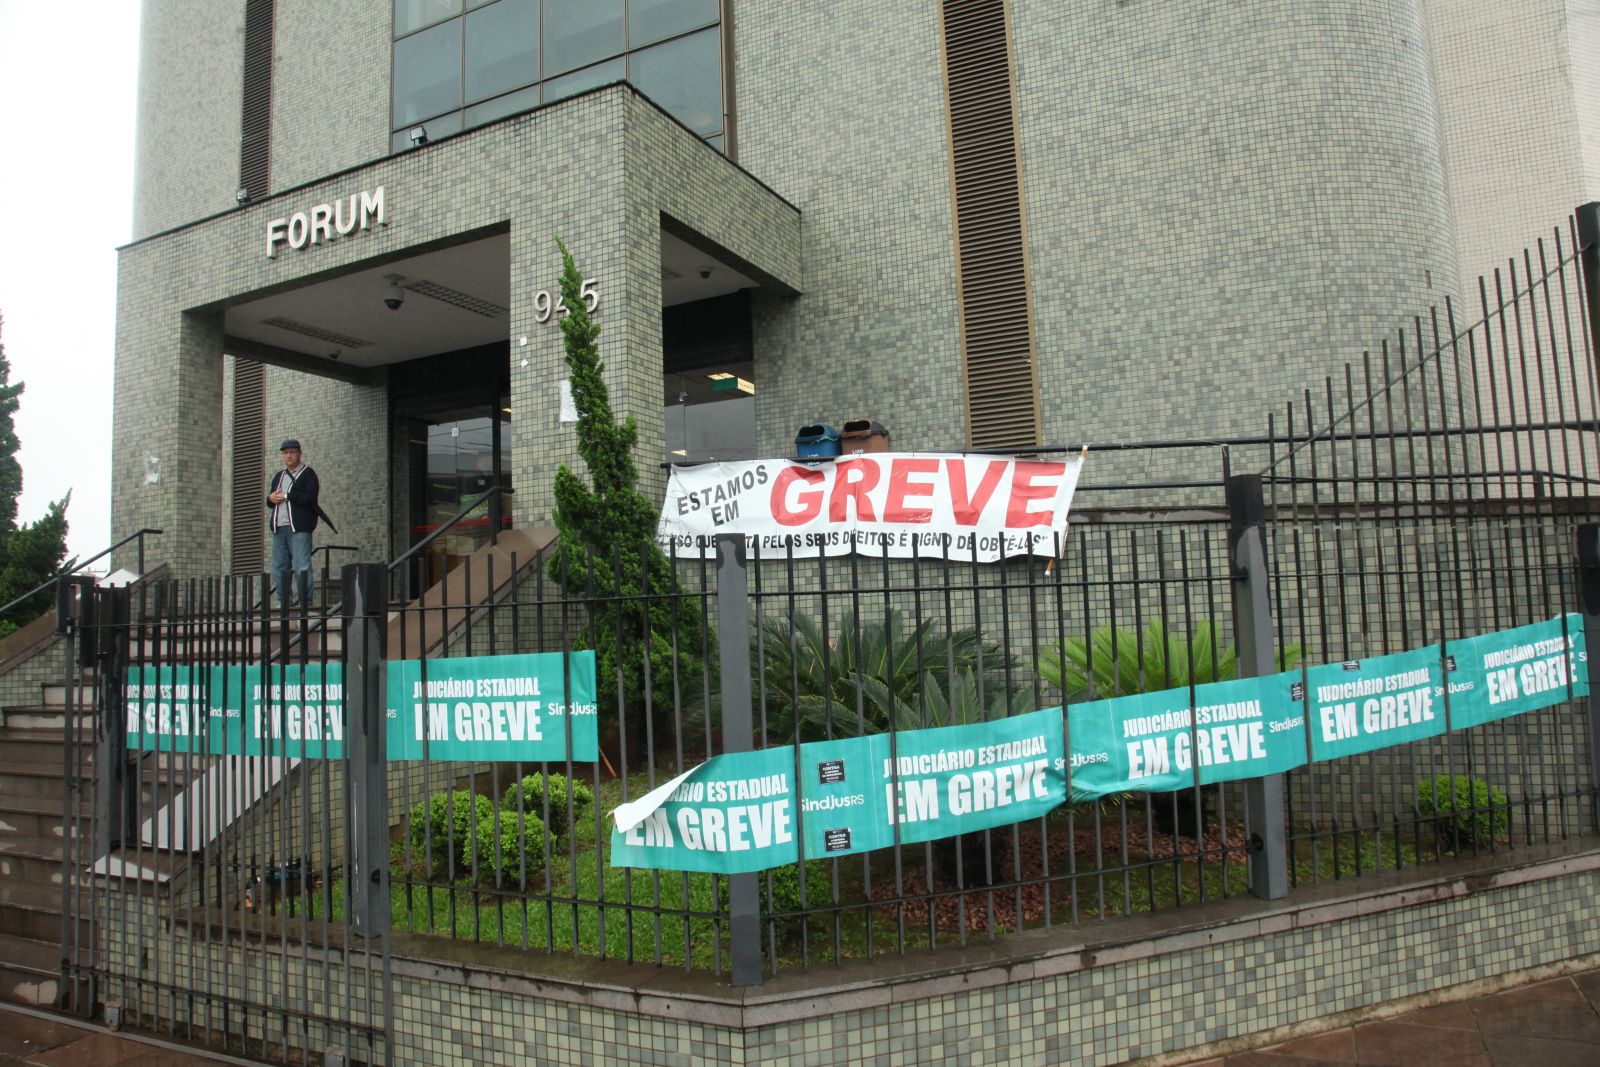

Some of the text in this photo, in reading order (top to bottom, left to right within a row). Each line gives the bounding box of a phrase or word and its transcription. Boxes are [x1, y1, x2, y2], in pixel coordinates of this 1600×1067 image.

[267, 184, 386, 258] FORUM
[677, 464, 769, 516] ESTAMOS
[769, 457, 1068, 529] GREVE
[710, 500, 740, 527] EM
[843, 529, 894, 547] DEITOS
[899, 529, 908, 547] É
[911, 532, 952, 548] IGNO
[1484, 644, 1535, 669] JUDICIÁRIO
[476, 677, 541, 698] ESTADUAL
[1317, 678, 1382, 703] JUDICIÁRIO
[1385, 667, 1431, 692] ESTADUAL
[1486, 651, 1578, 705] EM GREVE
[287, 704, 343, 741] GREV
[414, 701, 543, 742] EM GREVE
[1123, 699, 1263, 738] JUDICIÁRIO ESTADUAL
[1319, 687, 1435, 743] EM GREVE
[883, 735, 1048, 778] JUDICIÁRIO ESTADUAL
[1126, 721, 1267, 780] EM GREVE
[706, 773, 789, 802] ESTADUAL
[885, 759, 1049, 825] EM GREVE
[625, 799, 792, 852] EM GREVE
